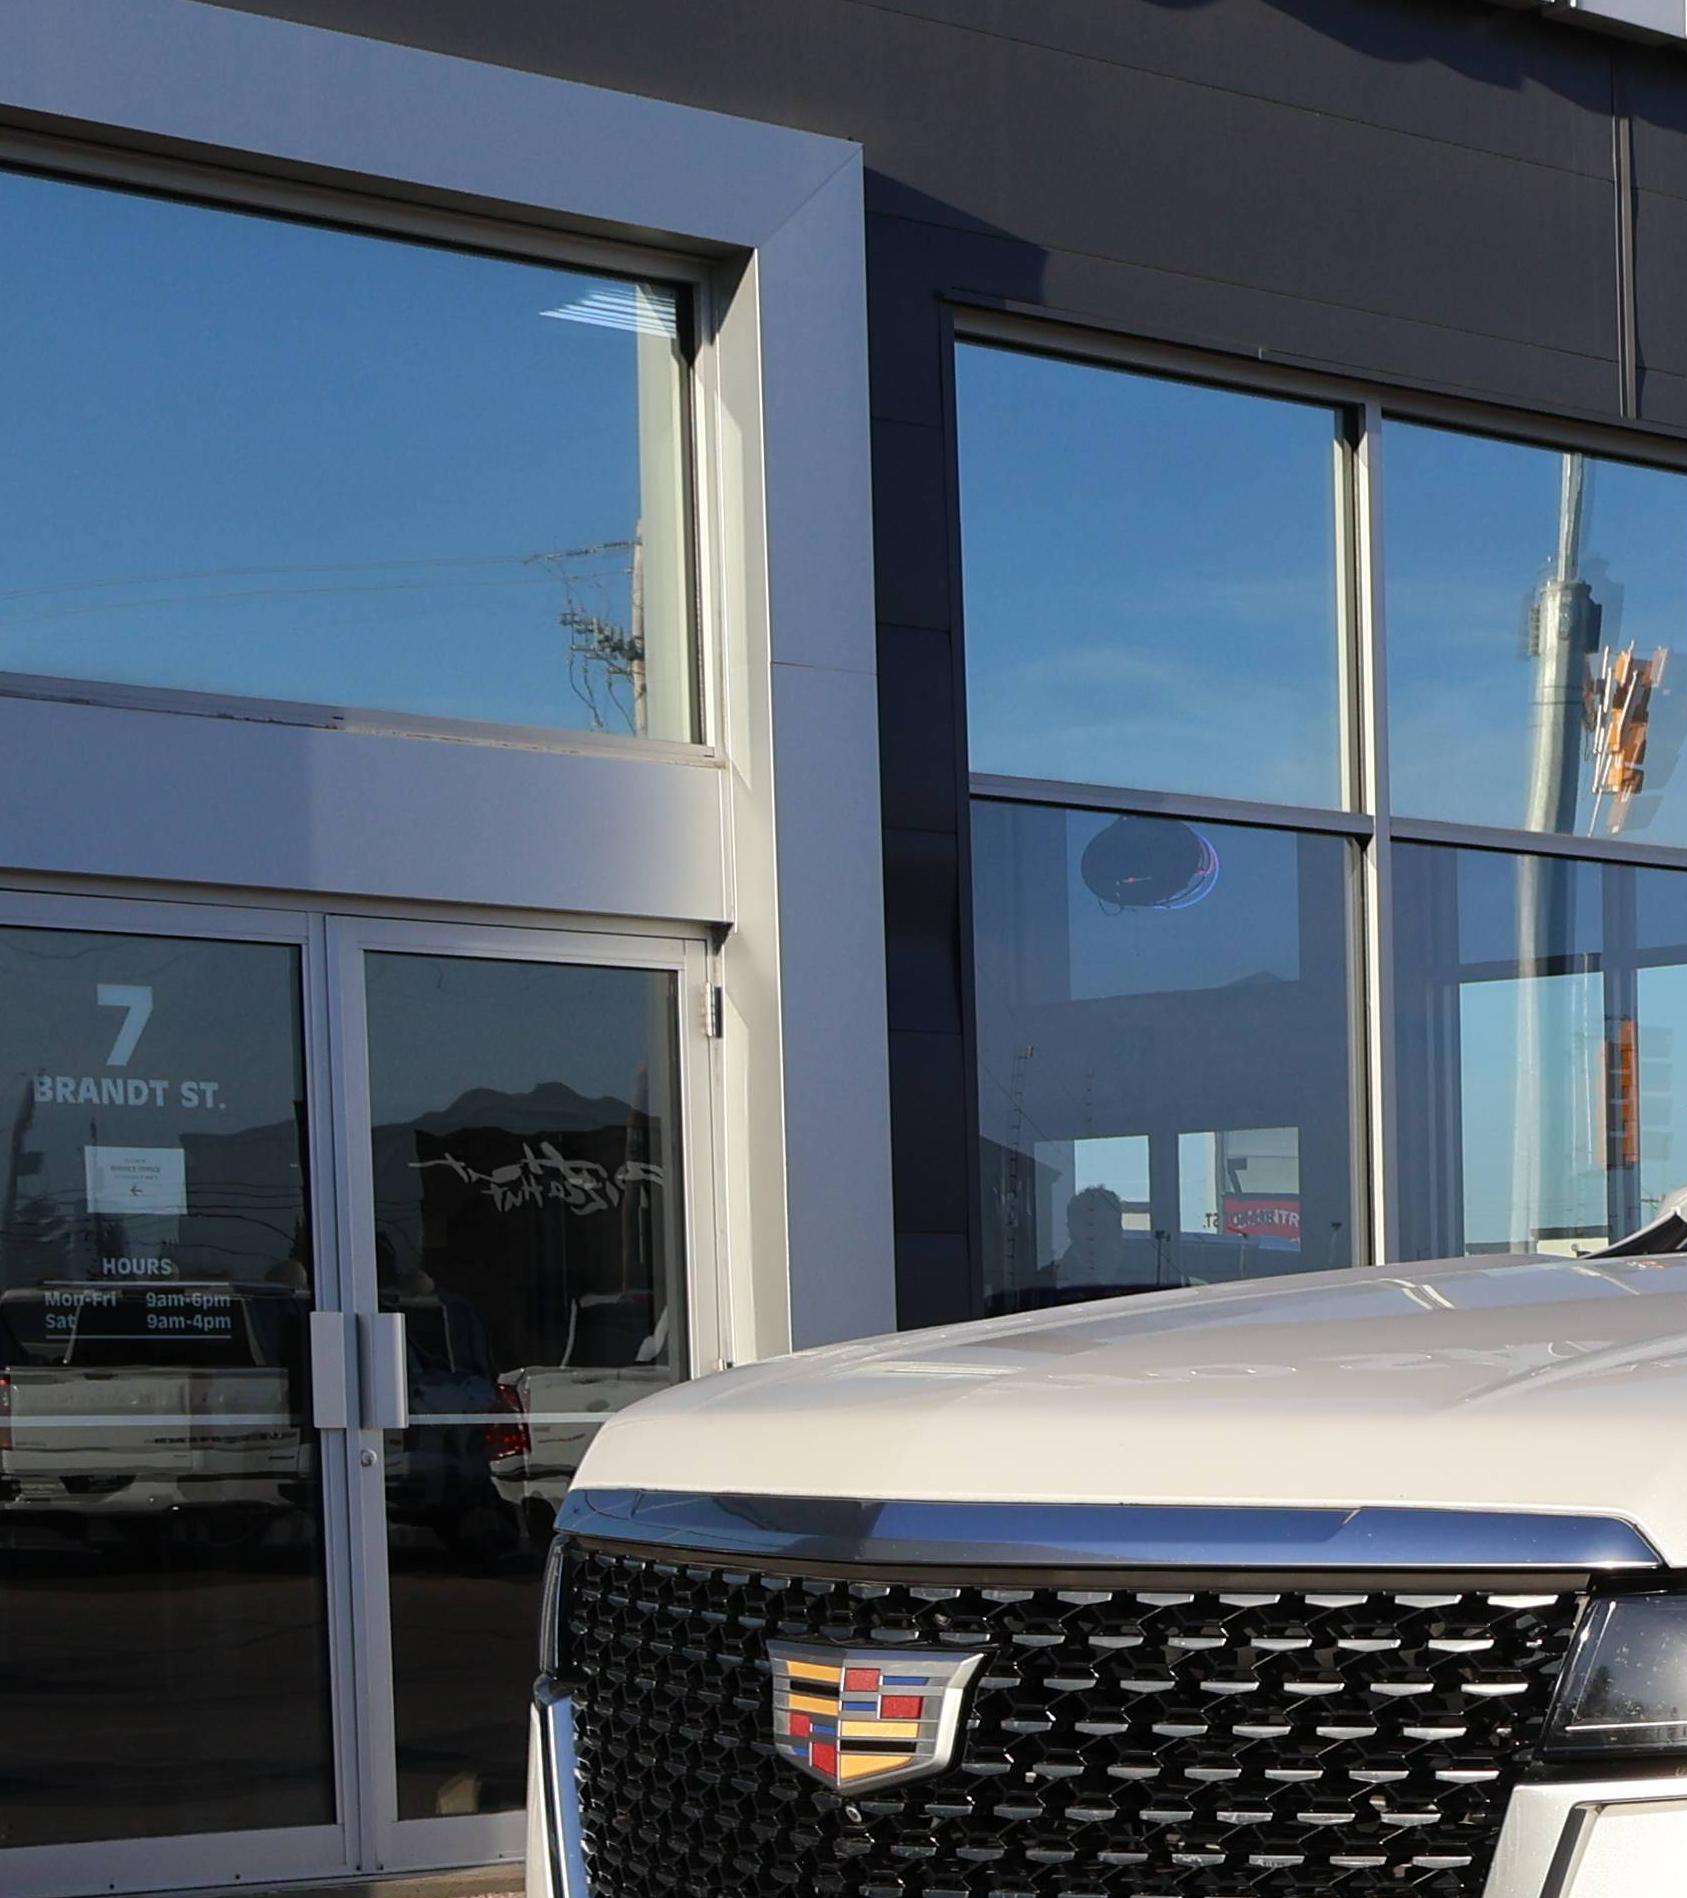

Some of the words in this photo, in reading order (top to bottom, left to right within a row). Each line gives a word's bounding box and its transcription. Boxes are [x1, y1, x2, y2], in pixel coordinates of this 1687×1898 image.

[96, 983, 154, 1067] 7
[33, 1075, 169, 1108] BRANDT
[179, 1080, 227, 1110] ST.
[102, 1257, 174, 1276] HOURS
[43, 1290, 117, 1308] Mon-Fri
[144, 1291, 232, 1311] 9am-6pm
[45, 1313, 78, 1330] Sat
[146, 1314, 232, 1332] 9am-4pm
